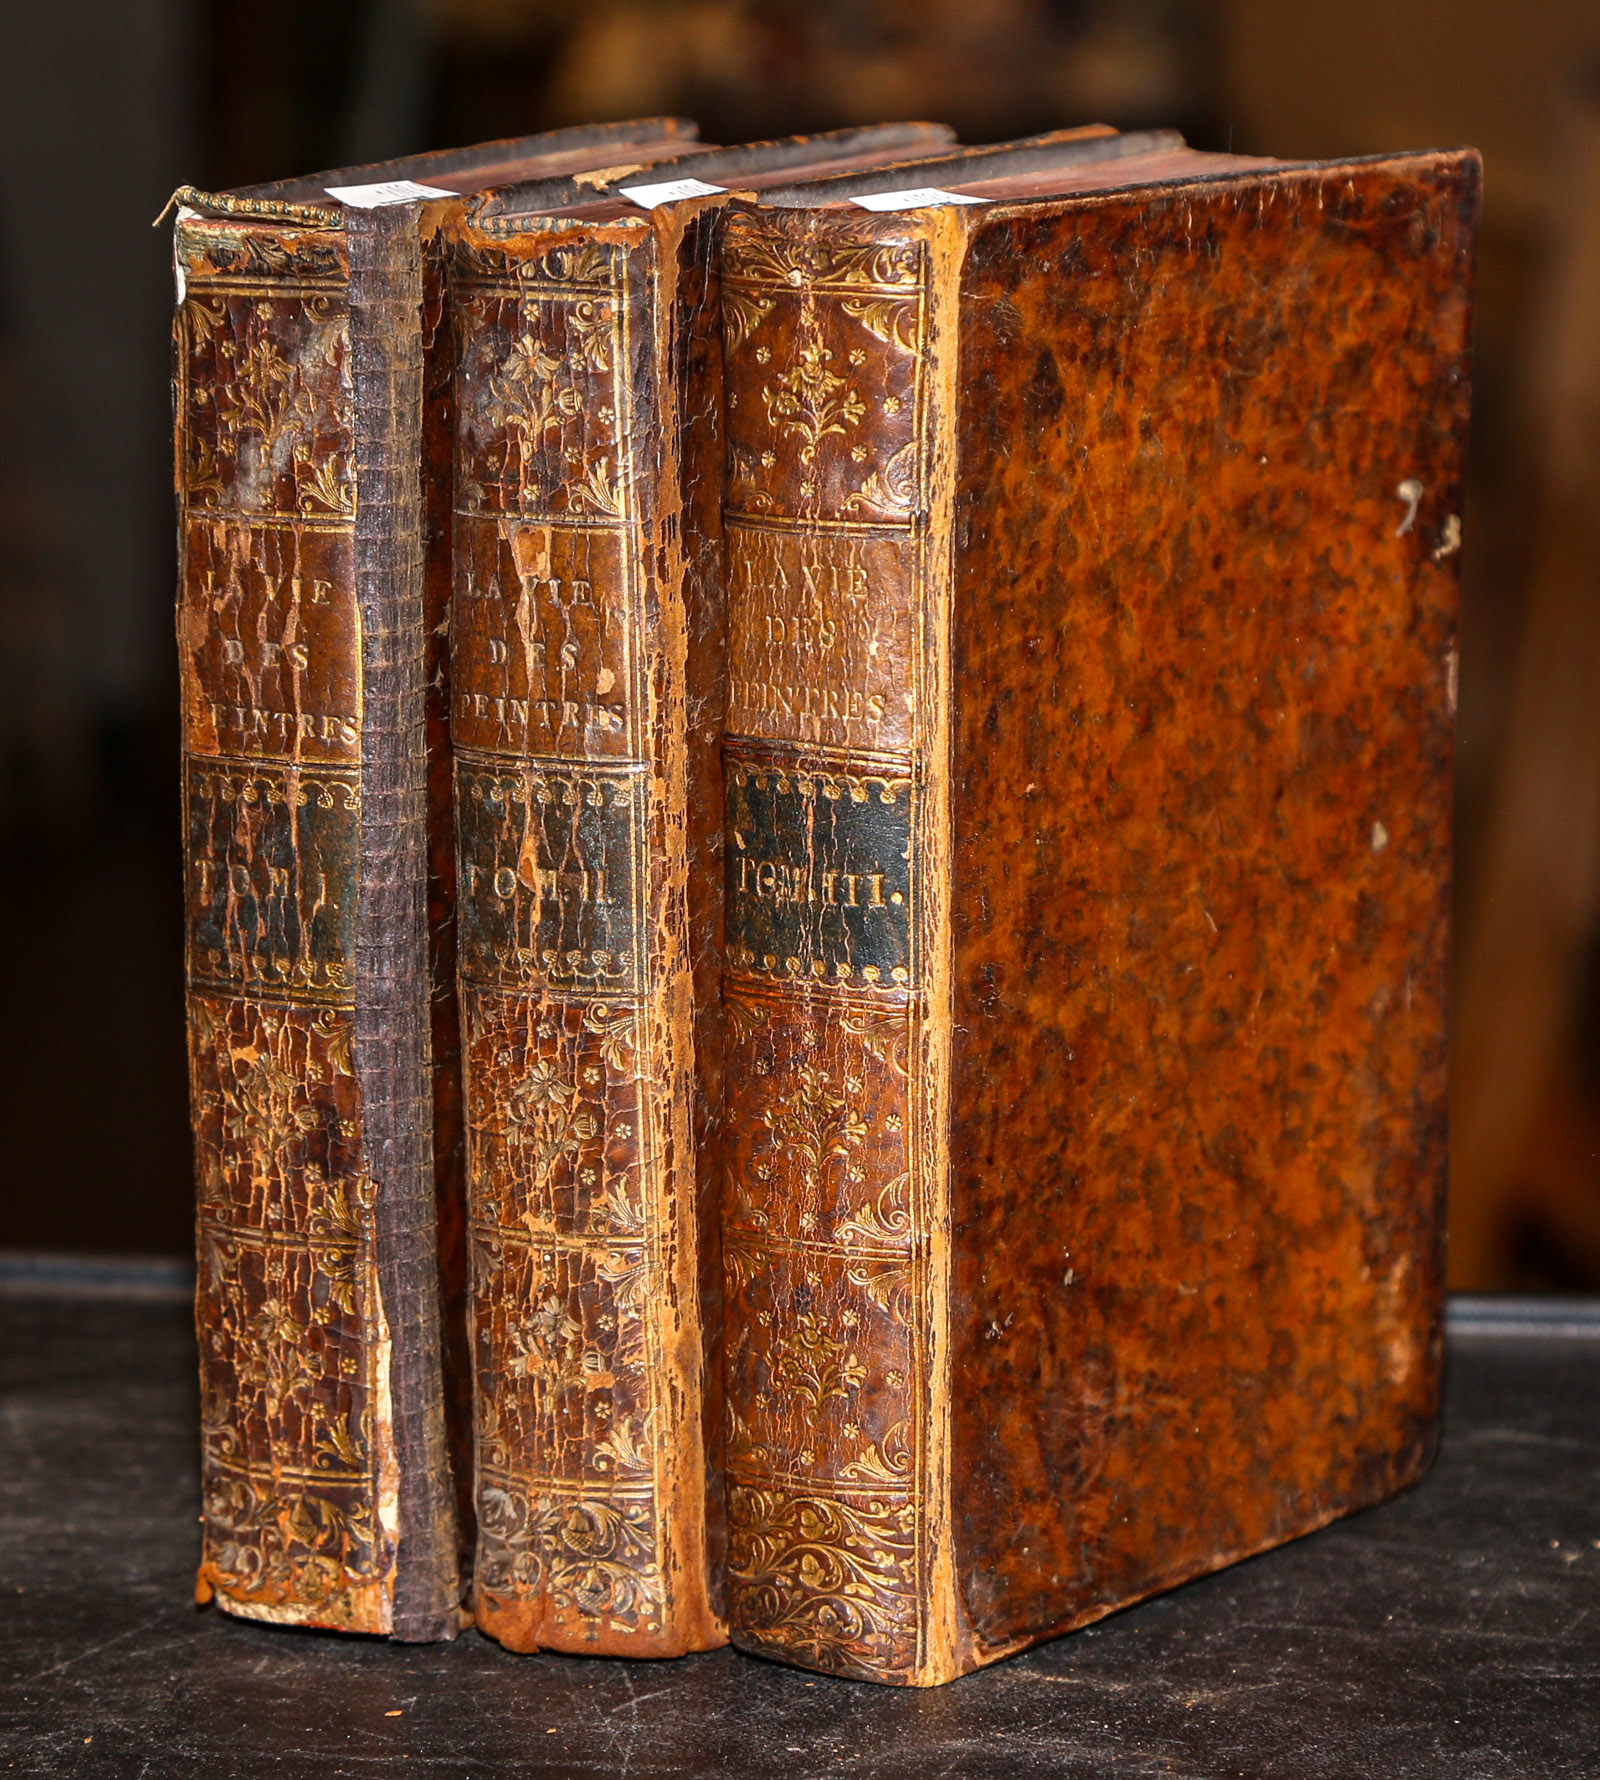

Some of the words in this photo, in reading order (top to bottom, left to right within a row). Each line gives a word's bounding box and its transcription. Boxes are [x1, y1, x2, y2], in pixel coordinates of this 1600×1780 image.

[224, 638, 310, 671] DES
[489, 639, 580, 671] DES
[205, 702, 358, 744] EINTRES
